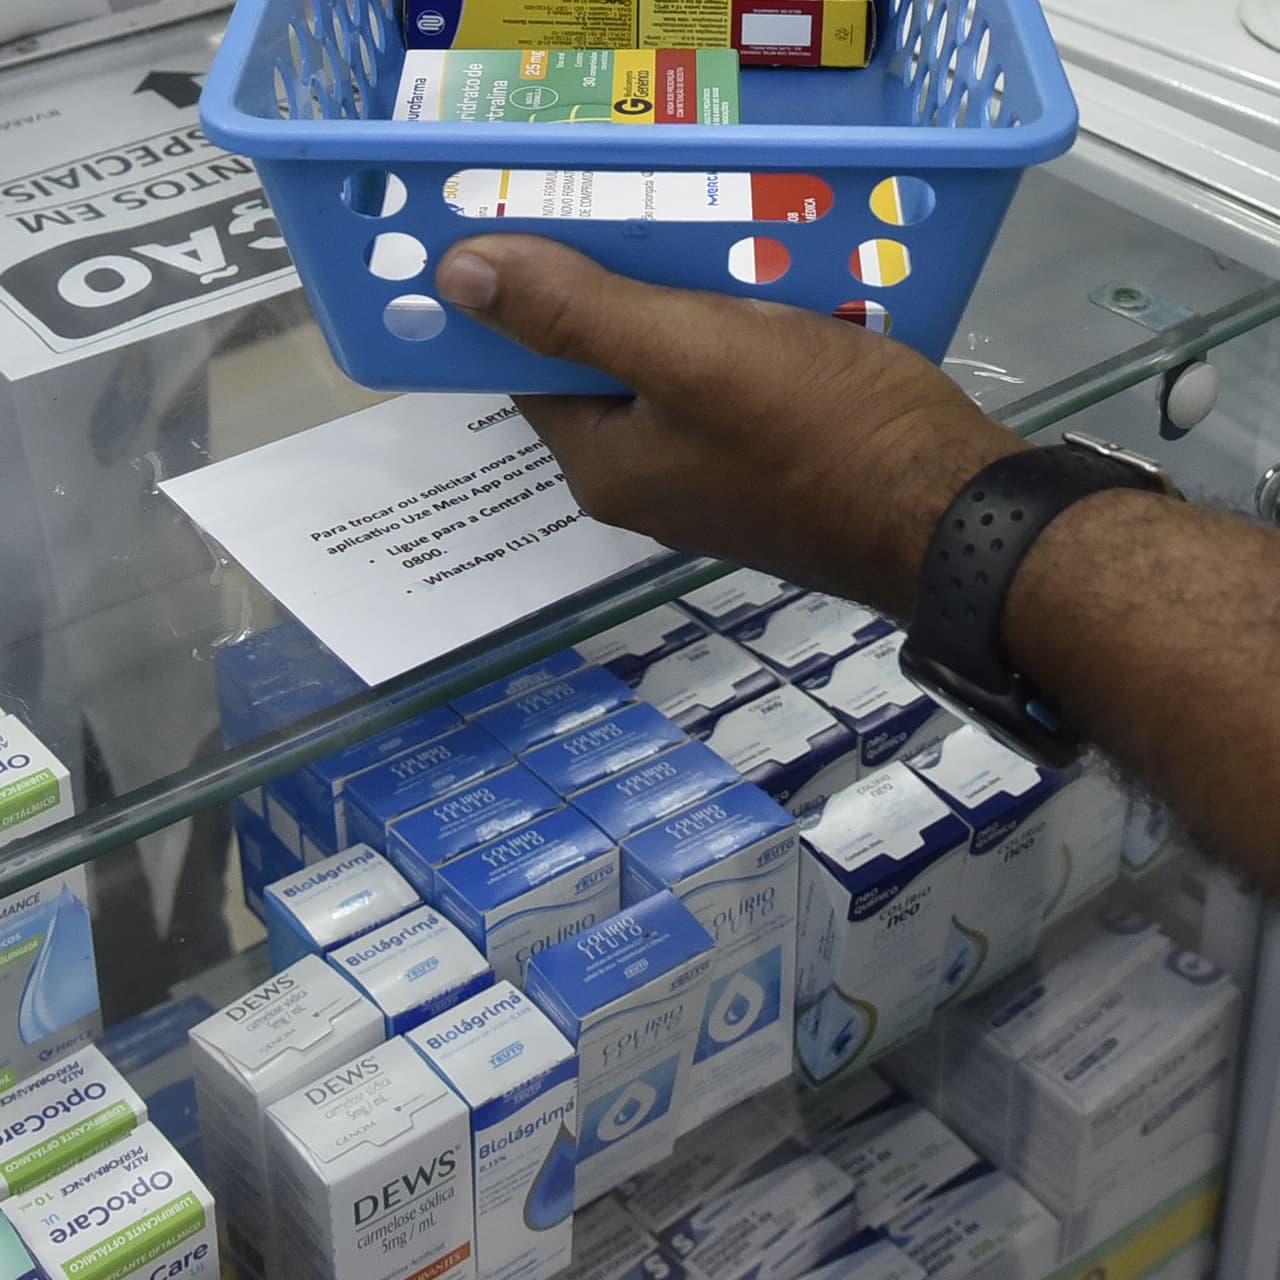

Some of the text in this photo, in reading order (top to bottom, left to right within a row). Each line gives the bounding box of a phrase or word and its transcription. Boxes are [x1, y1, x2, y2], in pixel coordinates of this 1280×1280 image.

[462, 63, 483, 77] de
[525, 61, 541, 75] 25
[532, 50, 546, 61] mg
[581, 76, 596, 87] 30
[633, 69, 650, 100] Genérico
[613, 98, 654, 116] G
[1, 128, 225, 205] SPECIAIS
[16, 156, 256, 234] NTOS EM
[542, 197, 555, 216] NOVA
[560, 171, 576, 217] NOVO FORMAT
[642, 180, 657, 210] prolongada
[310, 454, 517, 542] Para trocar ou solicitar nova
[326, 454, 555, 555] aplicativo Uze Meu App ou entr
[386, 535, 430, 558] Ligue
[431, 520, 468, 542] para
[470, 515, 480, 524] a
[480, 490, 534, 517] Central
[535, 479, 556, 493] de
[402, 547, 448, 569] 0800.
[423, 532, 541, 587] WhatsApp (11)
[2, 795, 56, 826] OFTÁLMICO
[854, 885, 899, 917] química
[515, 913, 596, 965] COLÍRIO
[576, 916, 637, 952] COLÍRIO
[225, 973, 296, 1022] DEWS
[58, 1066, 85, 1085] ALTA
[488, 1040, 525, 1069] TEUTO
[0, 1060, 79, 1107] PERFORMANCE
[304, 1056, 380, 1107] DEWS
[5, 1104, 126, 1173] LUBRIFICANTE OFTÁLMICO
[60, 1146, 143, 1198] PERFORMANCE
[122, 1152, 149, 1172] ALTA
[49, 1170, 173, 1245] OptoCare
[353, 1148, 457, 1226] DEWS
[69, 1196, 194, 1273] LUBRIFICANTE OFTÁLMICO
[149, 1221, 201, 1258] OFTÁLMICO
[357, 1207, 418, 1250] carmelose
[418, 1187, 455, 1217] sódica
[380, 1214, 438, 1255] 5mg mL
